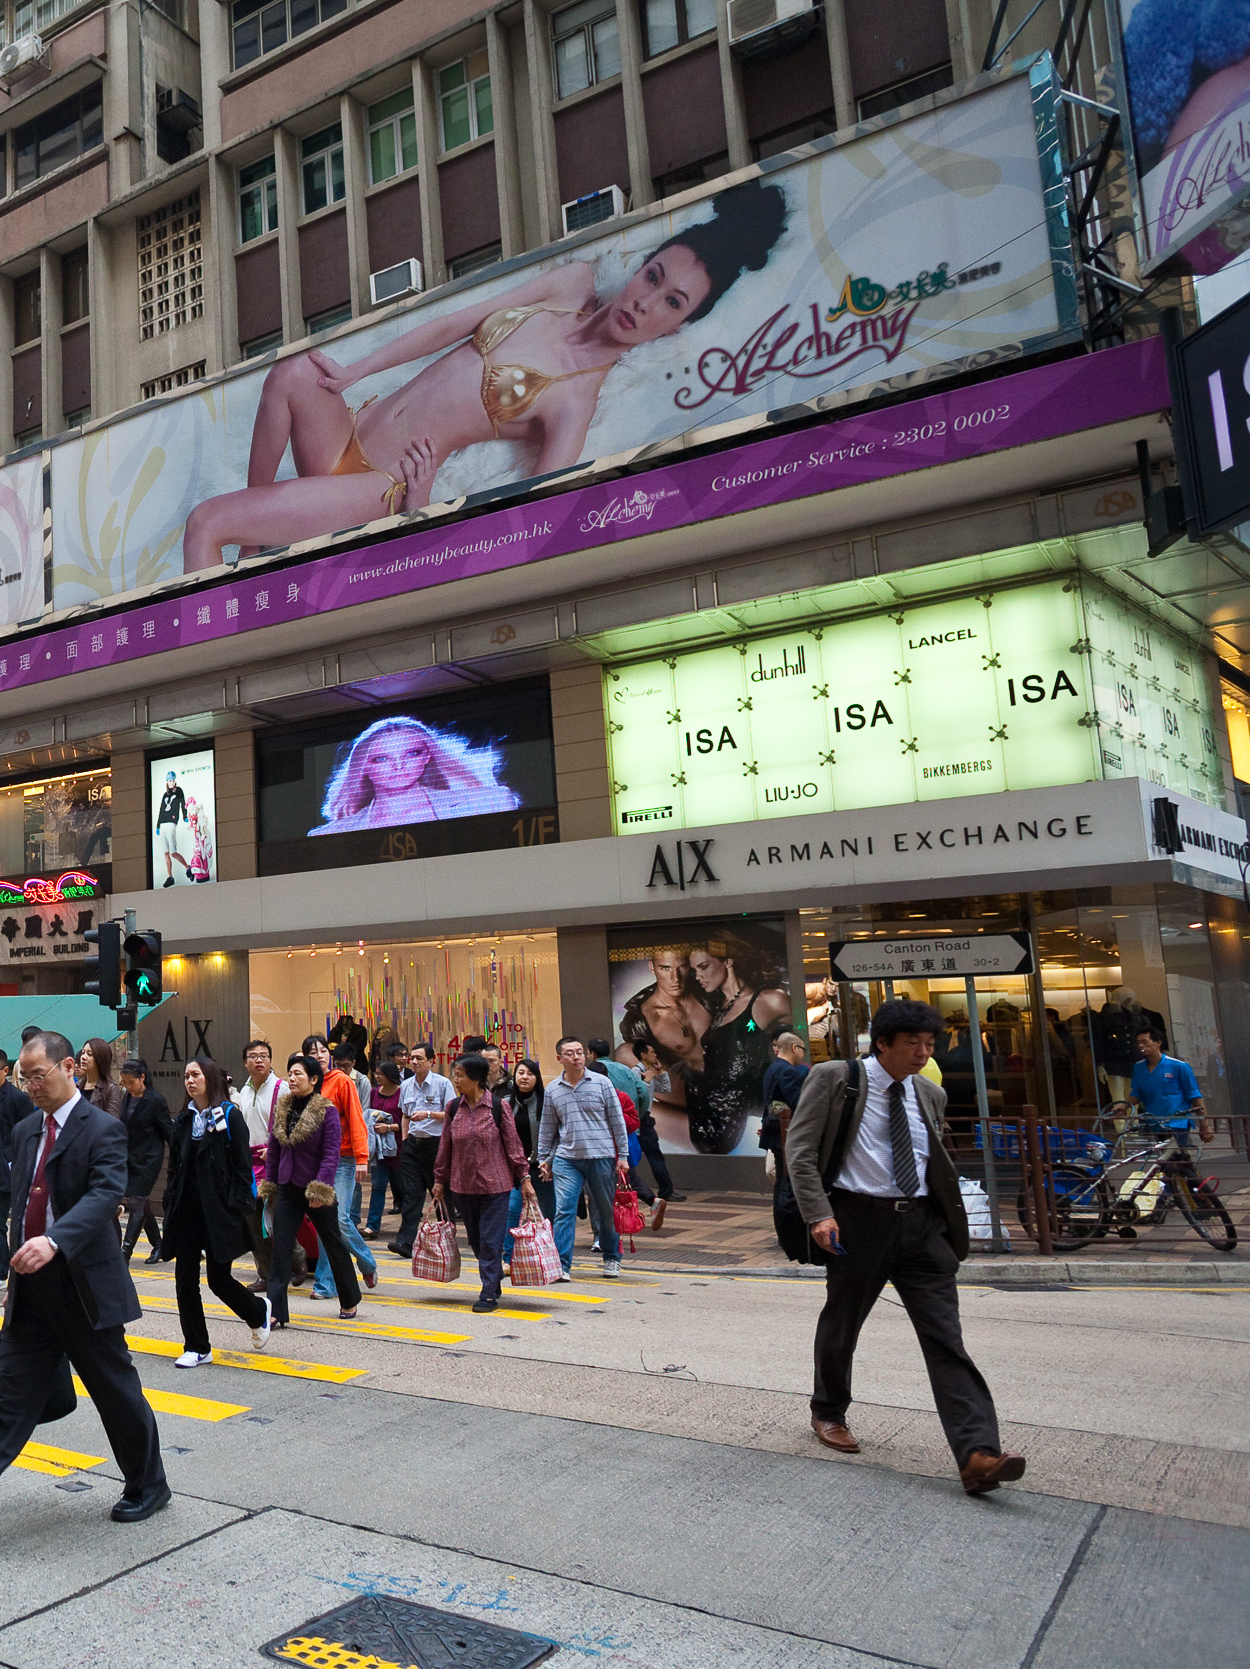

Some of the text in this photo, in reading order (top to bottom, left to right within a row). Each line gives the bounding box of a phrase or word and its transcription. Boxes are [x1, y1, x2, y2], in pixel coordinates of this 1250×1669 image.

[711, 460, 802, 492] Customer
[807, 441, 875, 468] Service
[893, 421, 947, 447] 2302
[953, 404, 1011, 432] 0002
[349, 520, 552, 584] www.alchemybeauty.com.hk
[66, 620, 156, 660] 面部護理
[197, 582, 300, 626] 纖體瘦身
[908, 628, 977, 649] LANCEL
[751, 645, 806, 682] dunhill
[1007, 670, 1078, 706] ISA
[1117, 681, 1137, 717] ISA
[833, 700, 893, 732] ISA
[1162, 706, 1180, 739] ISA
[686, 726, 737, 756] ISA
[1201, 727, 1219, 755] ISA
[923, 759, 992, 778] BIKKEMBERGS
[622, 805, 673, 824] PIRELLI
[746, 836, 874, 867] ARMANI
[895, 815, 1093, 851] EXCHANGE
[1180, 824, 1217, 852] ARMANI
[10, 942, 89, 958] IMPERIAL BUILDING
[883, 940, 970, 954] Canton Road
[852, 957, 1000, 973] 126-54A 廣東道 30-2
[488, 1023, 523, 1033] UP TO
[500, 1042, 523, 1051] OFF
